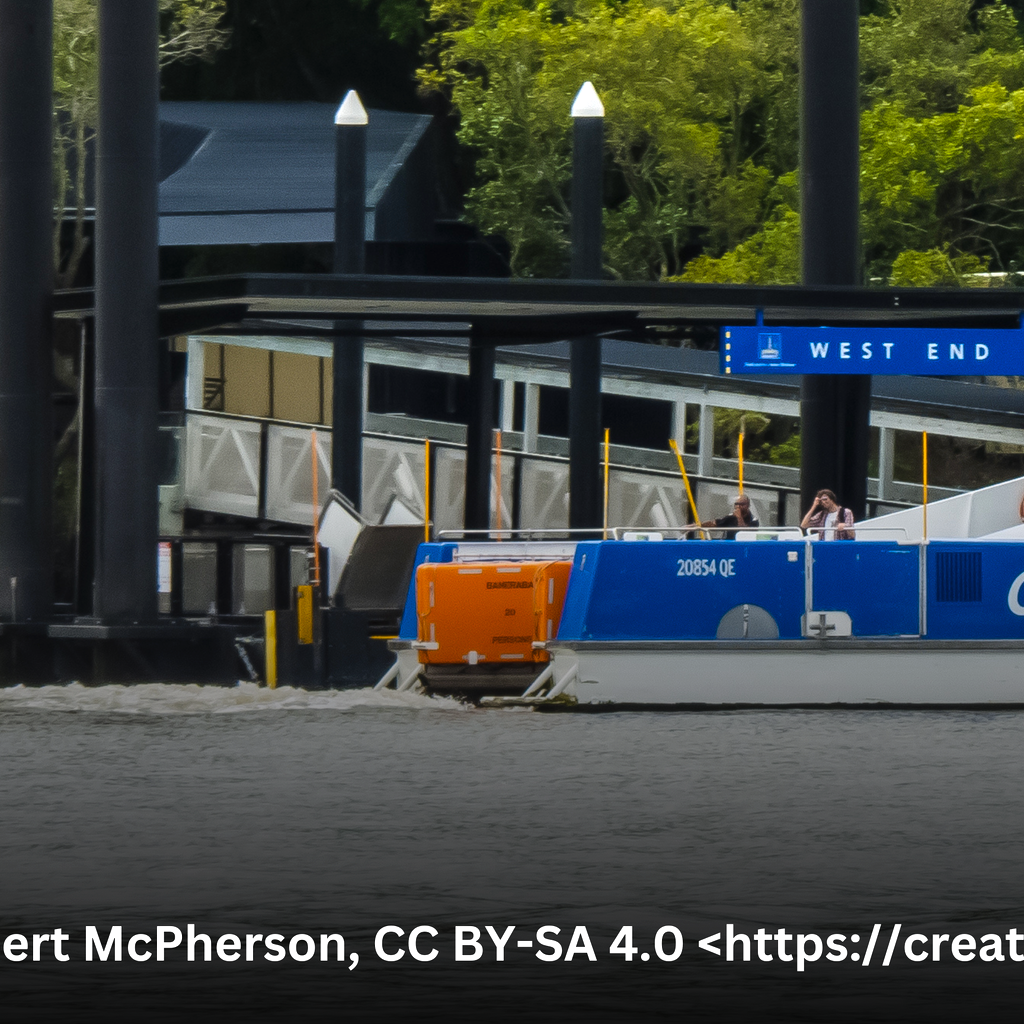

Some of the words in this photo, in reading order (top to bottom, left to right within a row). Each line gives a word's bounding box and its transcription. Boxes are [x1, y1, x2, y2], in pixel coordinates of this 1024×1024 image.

[810, 342, 895, 360] WEST
[928, 343, 990, 360] END
[677, 558, 717, 577] 20854
[719, 558, 736, 578] QE
